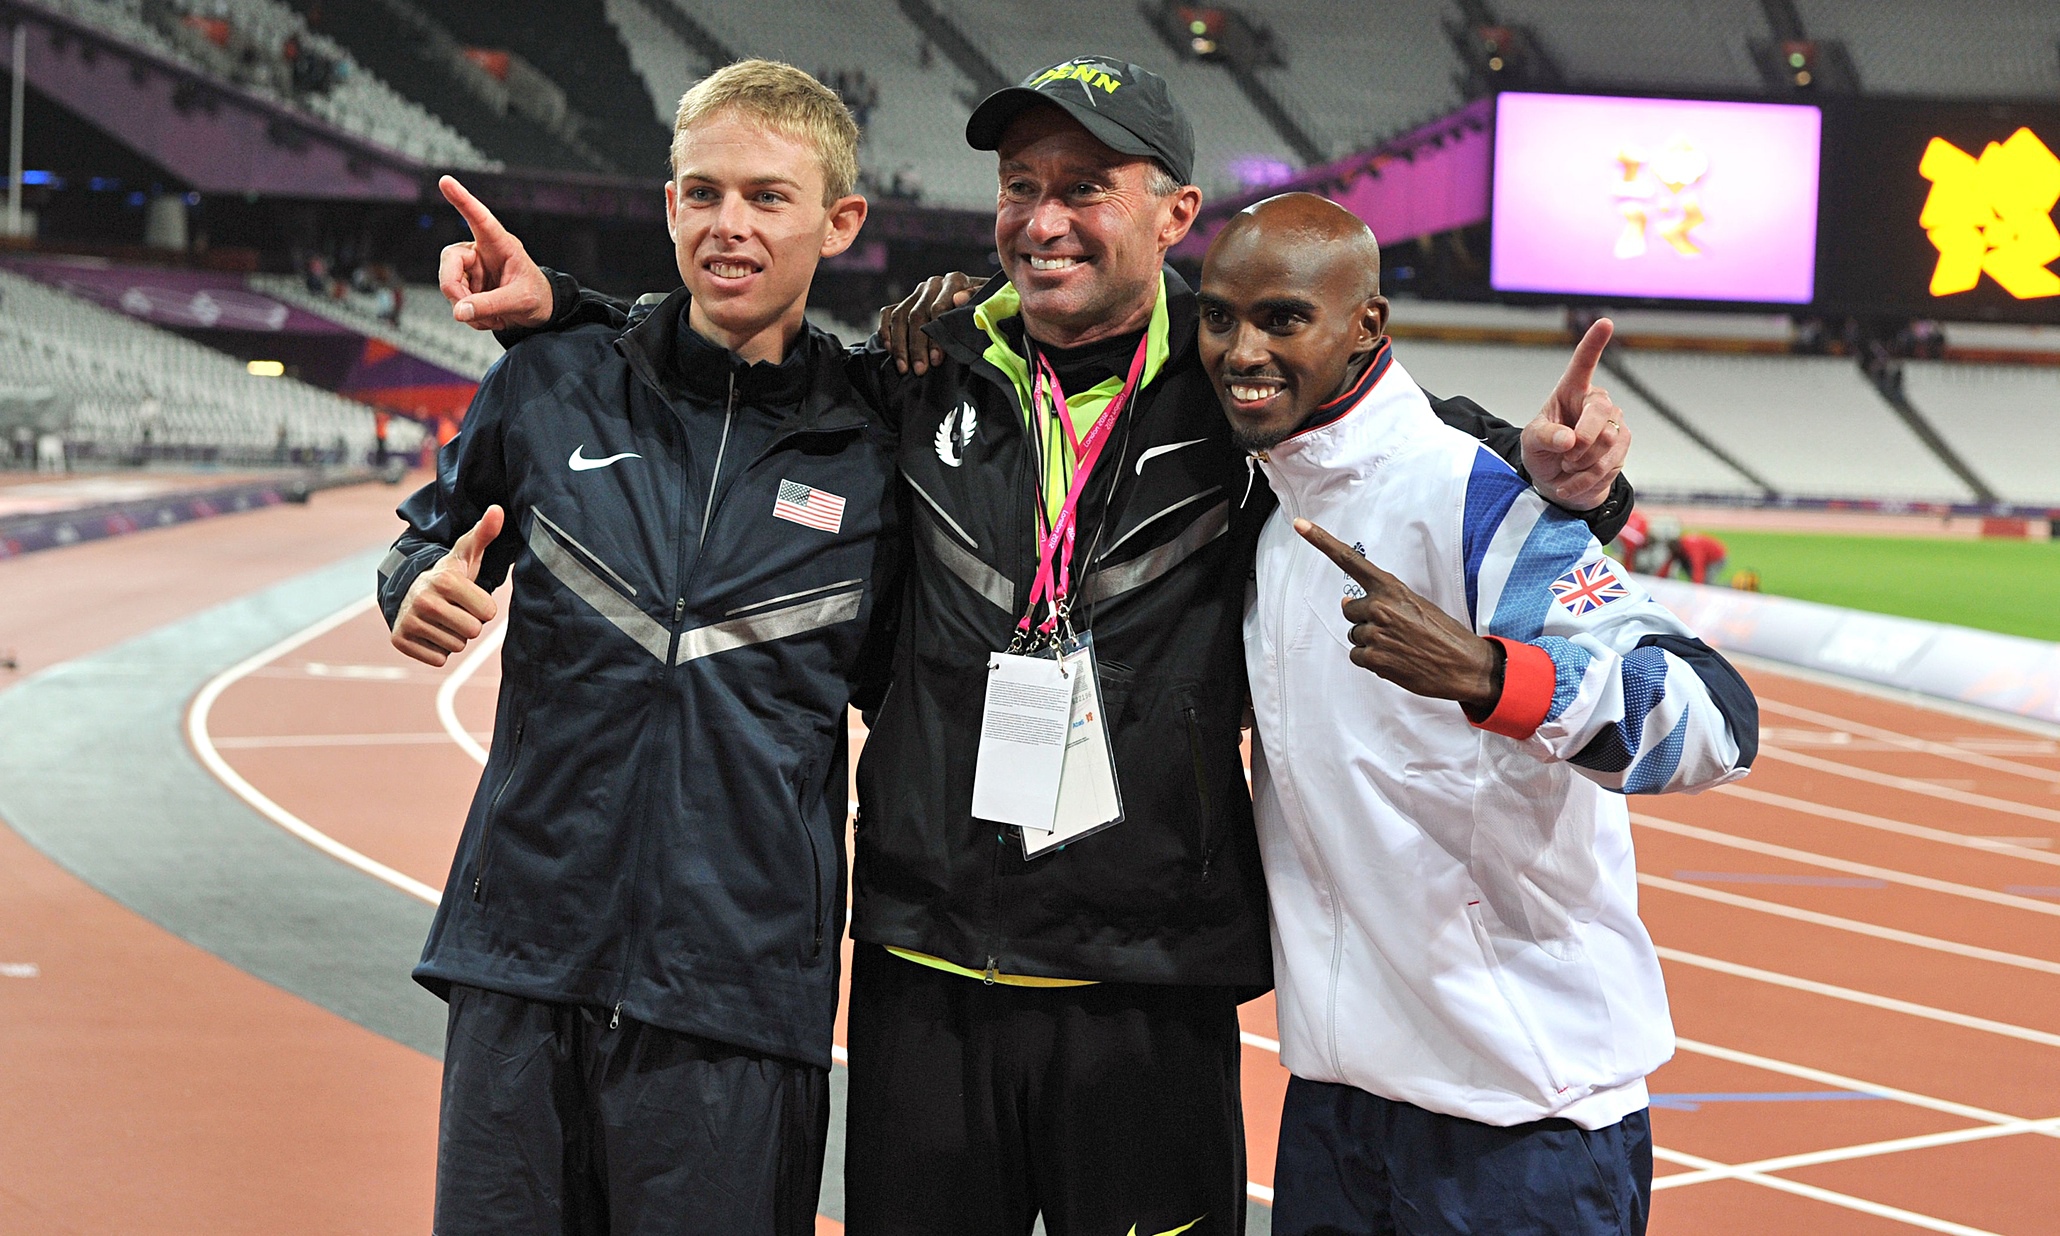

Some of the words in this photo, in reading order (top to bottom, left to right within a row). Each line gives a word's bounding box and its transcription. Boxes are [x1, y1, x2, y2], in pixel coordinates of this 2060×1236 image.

[1030, 64, 1121, 94] PENN
[1112, 392, 1126, 415] London
[1083, 426, 1100, 448] London
[1098, 412, 1108, 426] 2012
[1105, 415, 1115, 430] 2012
[1055, 510, 1068, 533] London
[1048, 533, 1059, 549] 2012
